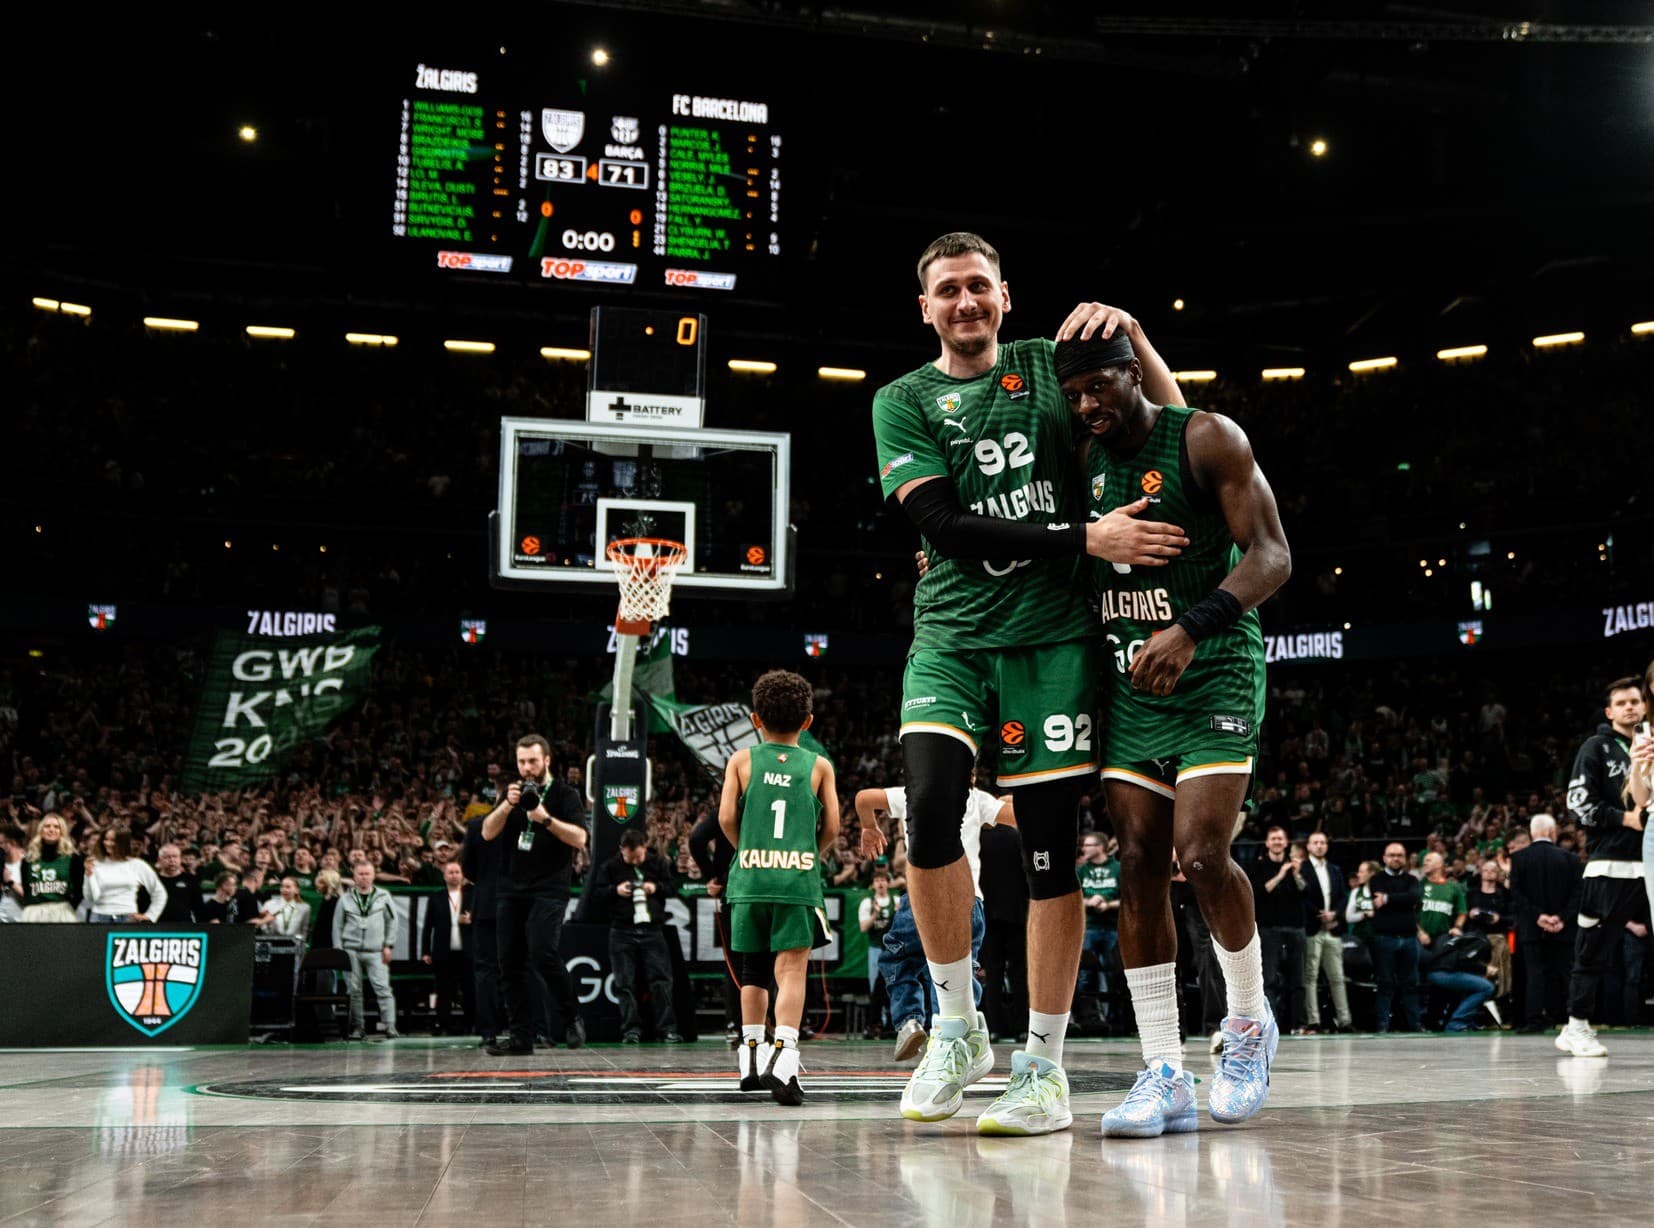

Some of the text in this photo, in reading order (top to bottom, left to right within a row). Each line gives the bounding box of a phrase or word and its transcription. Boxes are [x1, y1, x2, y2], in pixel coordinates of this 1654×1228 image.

[416, 63, 478, 94] ŽALGIRIS
[673, 94, 768, 124] FC BARCELONA
[605, 144, 644, 160] BARÇA
[543, 159, 574, 180] 83
[586, 163, 598, 180] 4
[607, 165, 635, 185] 71
[562, 229, 615, 252] 0:00
[677, 317, 698, 345] 0
[633, 405, 682, 416] BATTERY
[974, 432, 1036, 476] 92
[1102, 588, 1173, 625] ALGIRIS
[1265, 631, 1343, 663] ZALGIRIS
[1043, 713, 1092, 752] 92
[763, 771, 792, 787] NAZ
[771, 799, 786, 839] 1
[739, 849, 815, 871] KAUNAS
[113, 938, 201, 968] ZALGIRIS
